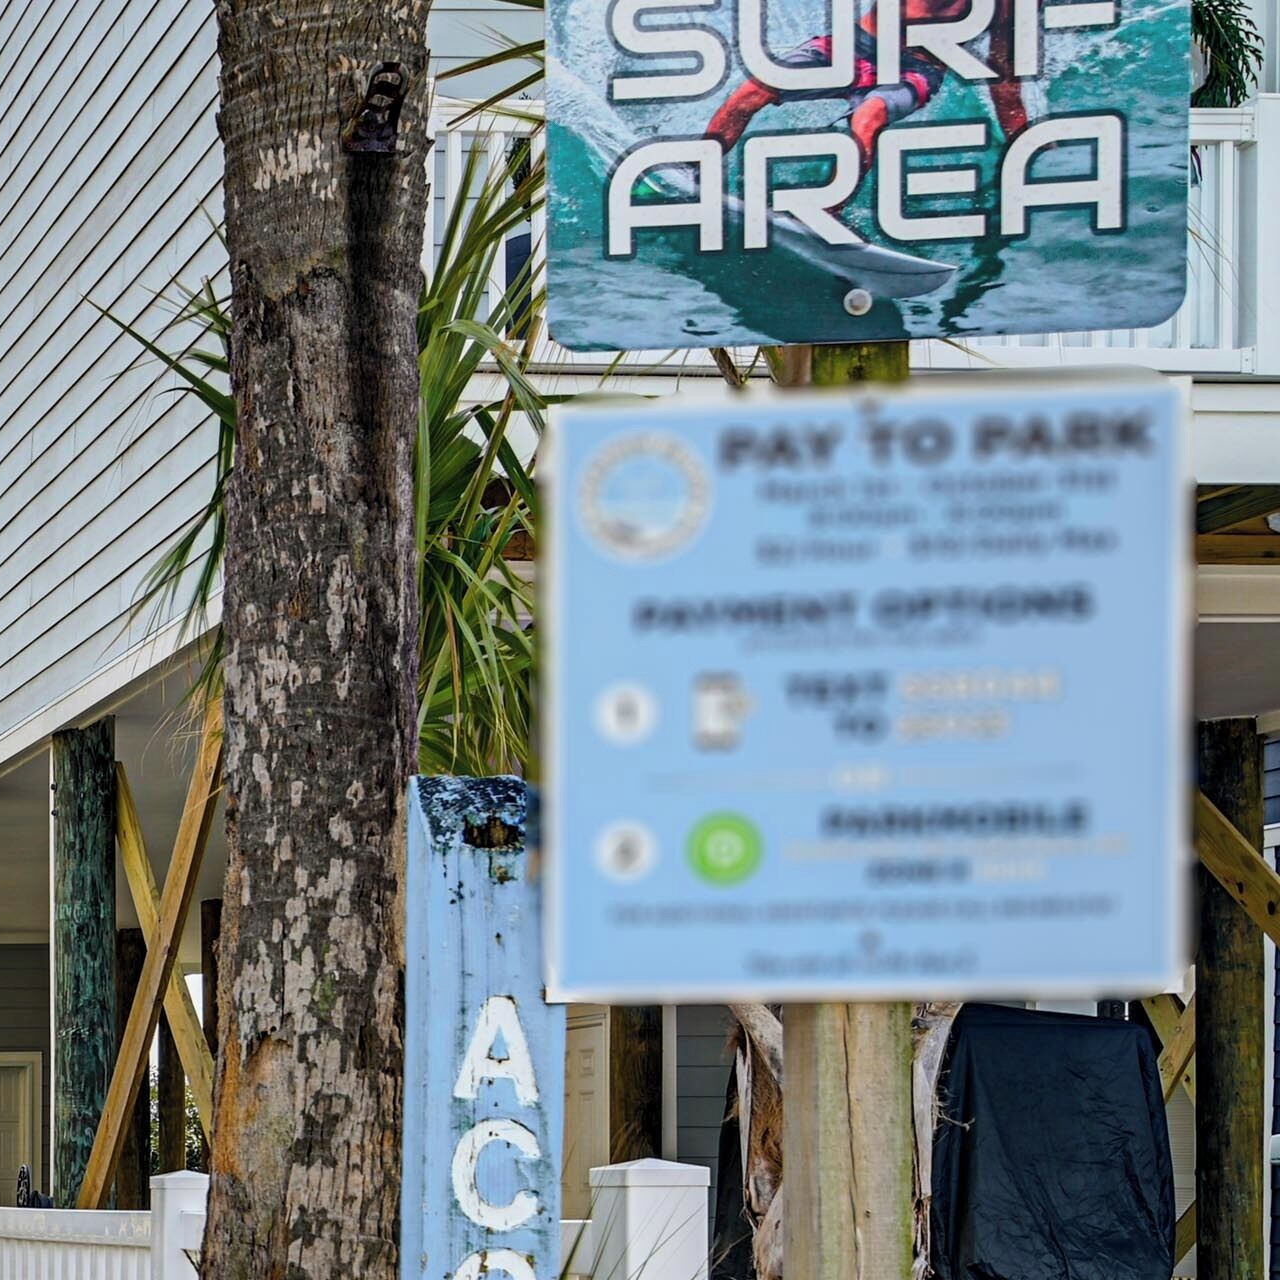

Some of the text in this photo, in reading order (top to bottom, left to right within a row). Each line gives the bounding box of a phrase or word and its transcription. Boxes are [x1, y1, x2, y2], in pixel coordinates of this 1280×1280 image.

[610, 0, 1115, 100] SURF
[608, 114, 1123, 256] AREA
[717, 408, 1156, 472] PAY TO PARK
